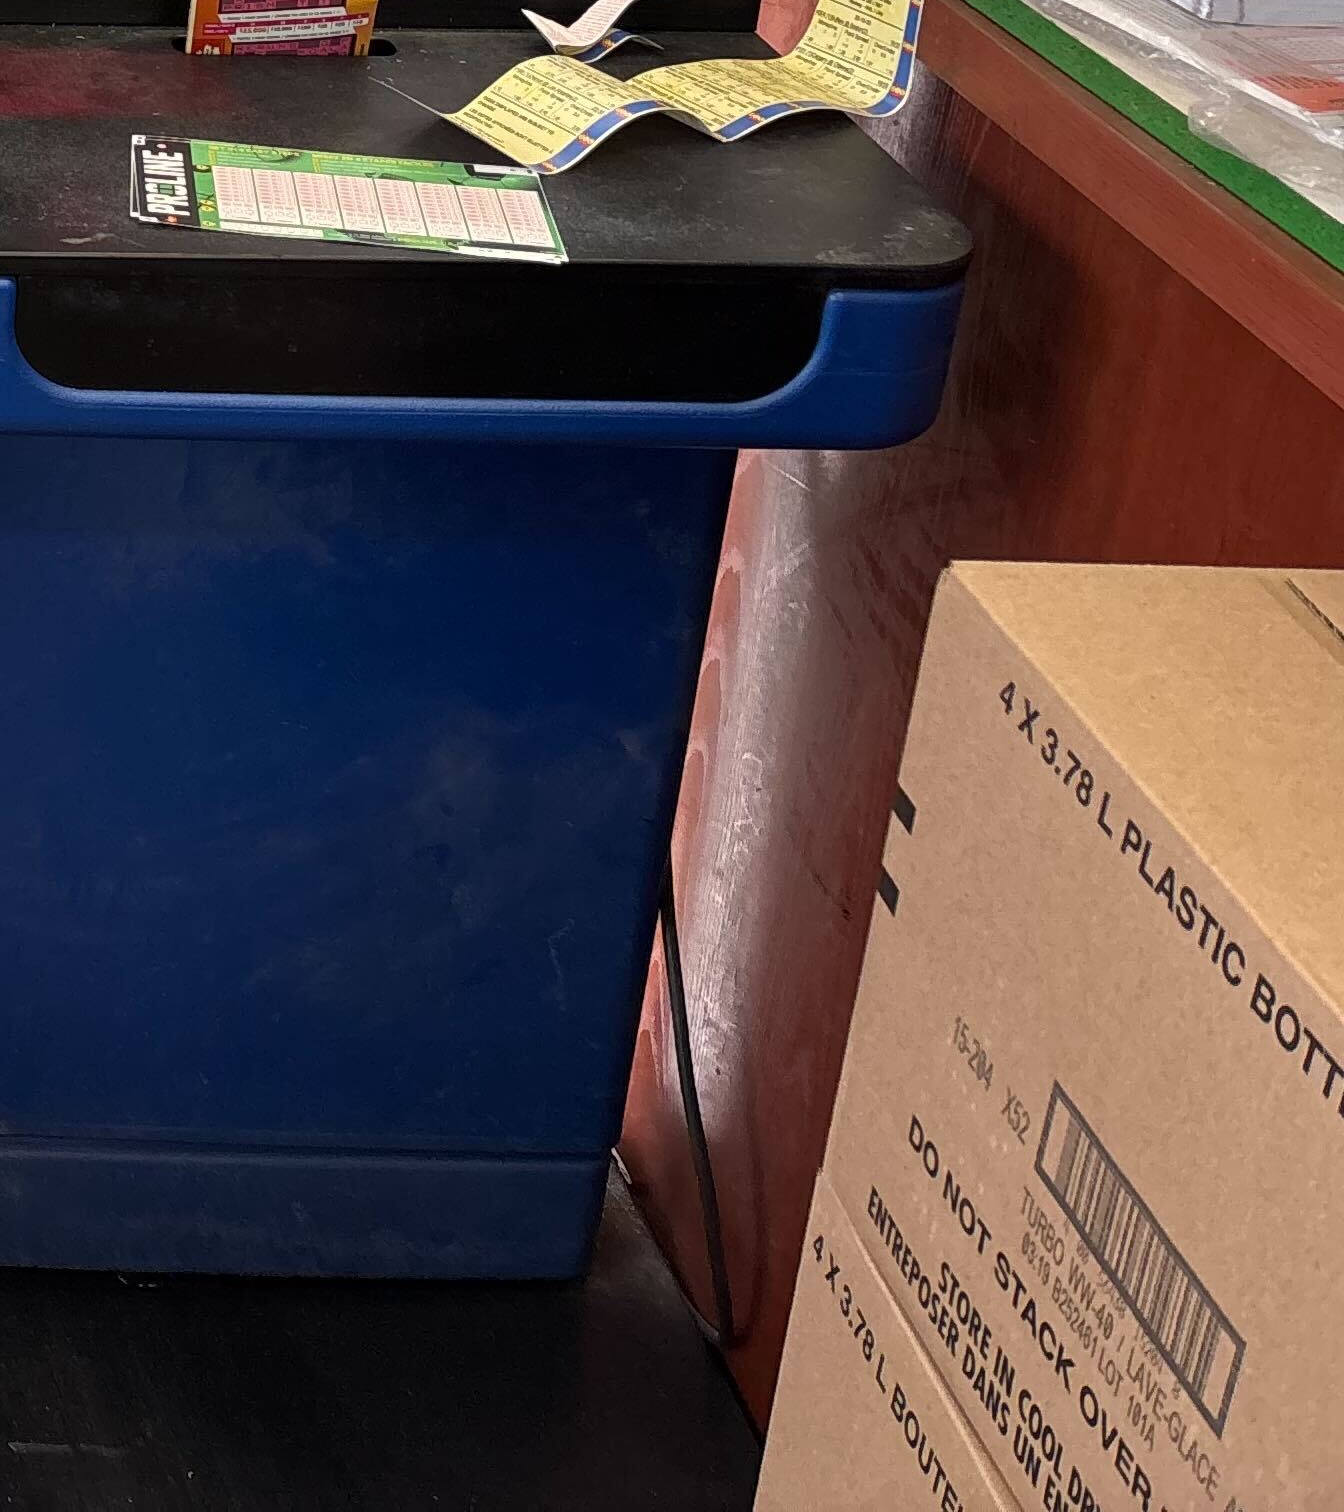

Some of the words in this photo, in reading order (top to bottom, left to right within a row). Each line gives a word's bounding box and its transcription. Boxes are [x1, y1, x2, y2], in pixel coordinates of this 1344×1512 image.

[146, 149, 190, 216] PROLINE
[999, 680, 1016, 714] 4
[1018, 698, 1040, 743] X
[1041, 728, 1095, 807] 3.78
[1098, 792, 1113, 839] L
[1121, 818, 1246, 986] PLASTIC
[1250, 973, 1344, 1118] BOTT
[868, 1185, 961, 1356] ENTREPOSER
[962, 1345, 1010, 1436] DANS
[1013, 1424, 1041, 1487] UN
[909, 1115, 939, 1178] DO
[943, 1170, 992, 1255] NOT
[995, 1252, 1076, 1394] STACK
[1080, 1385, 1152, 1512] OVER
[938, 1262, 992, 1361] STORE
[994, 1346, 1015, 1398] IN
[1019, 1389, 1062, 1480] COOL
[1020, 1187, 1065, 1266] TURBO
[1127, 1349, 1220, 1502] LAVE-GLACE
